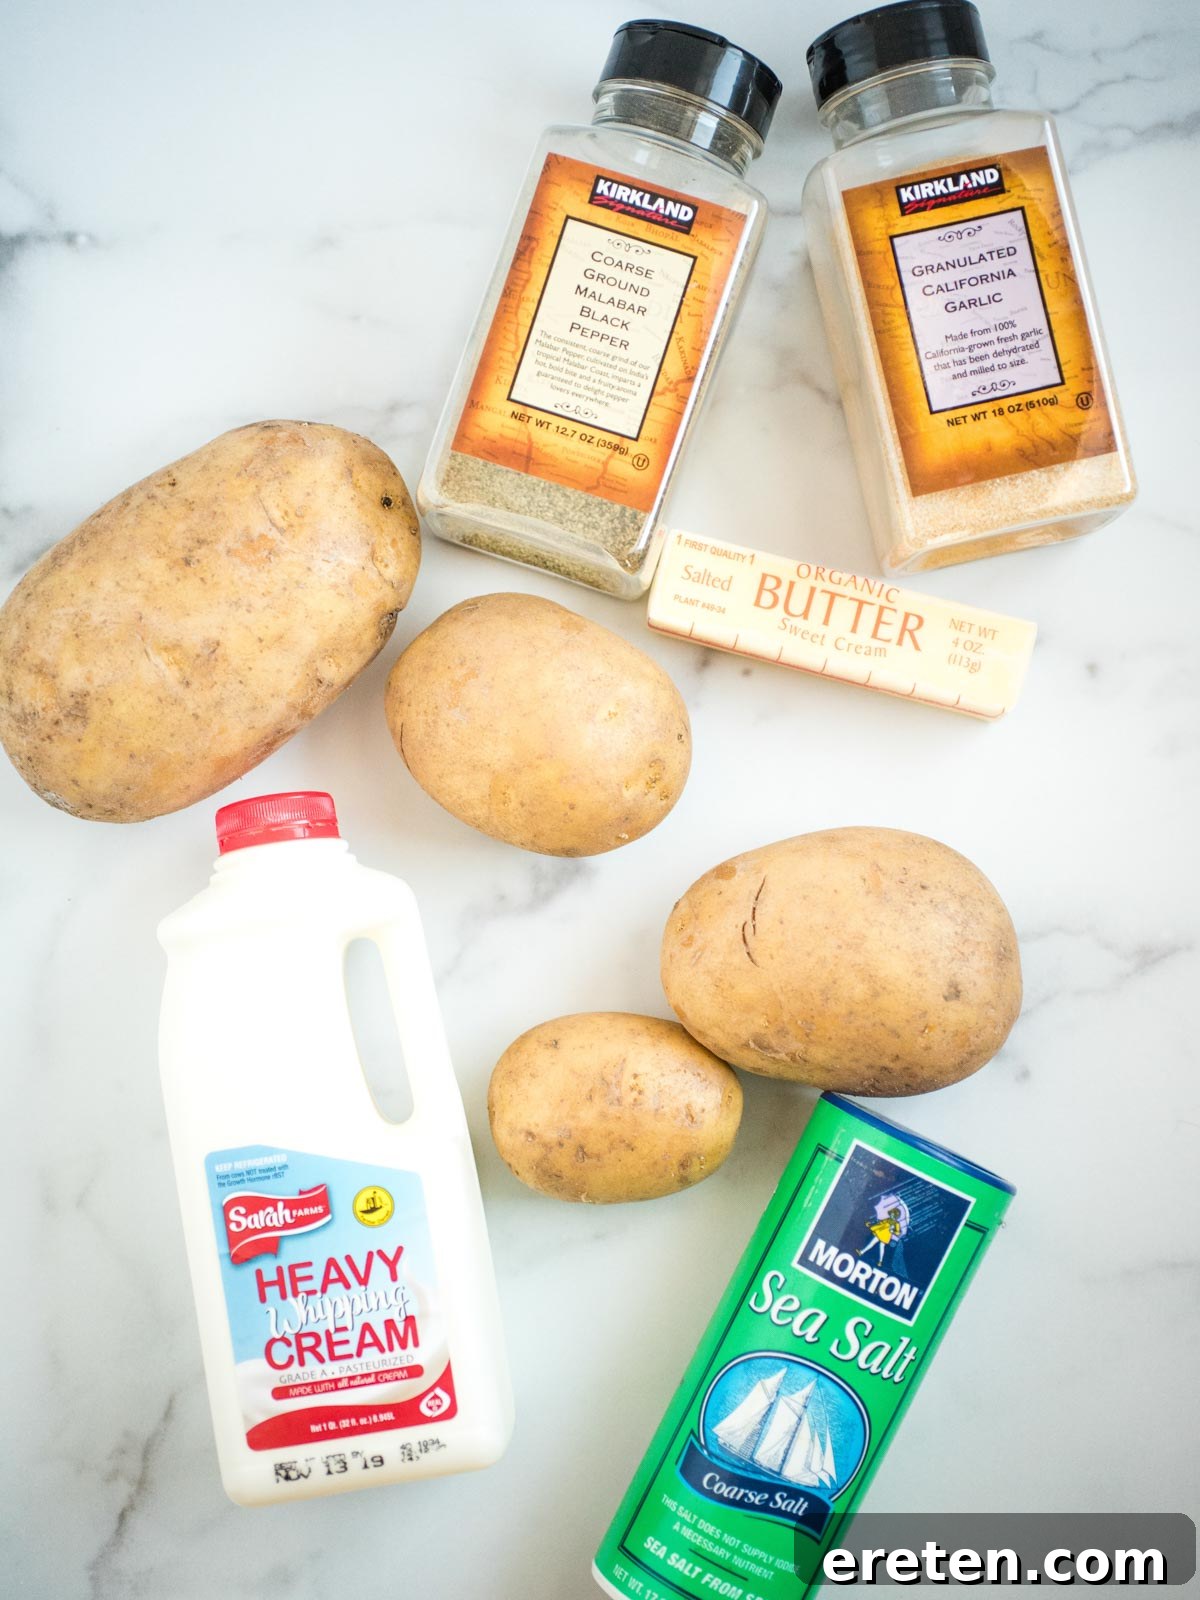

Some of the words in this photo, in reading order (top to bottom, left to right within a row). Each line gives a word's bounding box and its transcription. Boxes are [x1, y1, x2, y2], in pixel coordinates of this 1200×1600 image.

[596, 179, 693, 221] KIRKLAND
[900, 168, 999, 202] KIRKLAND
[904, 187, 999, 214] Signature
[592, 196, 689, 230] Signature
[590, 251, 655, 279] COARSE
[912, 246, 1017, 277] GRANULATED
[583, 268, 650, 297] GROUND
[922, 268, 1017, 297] CALIFORNIA
[575, 285, 647, 316] MALABAR
[944, 292, 1003, 313] GARLIC
[580, 306, 631, 331] BLACK
[945, 331, 969, 344] Made
[970, 326, 992, 338] from
[994, 320, 1017, 332] 100%
[540, 330, 552, 340] The
[553, 336, 587, 351] consistent,
[589, 346, 610, 358] coarse
[611, 353, 629, 364] grind
[630, 359, 638, 367] of
[569, 322, 630, 350] PEPPER
[925, 337, 995, 360] California-grown
[997, 333, 1018, 346] fresh
[1020, 327, 1043, 341] garlic
[535, 339, 560, 352] Malabar
[586, 355, 618, 370] cultivated
[618, 366, 628, 374] on
[536, 350, 561, 362] tropical
[563, 357, 588, 370] Malabar
[611, 374, 636, 386] imparts
[933, 361, 951, 372] that
[952, 357, 967, 368] has
[969, 352, 990, 364] been
[992, 341, 1040, 360] dehydrated
[952, 369, 968, 380] and
[969, 363, 996, 377] milled
[997, 362, 1007, 370] to
[1009, 358, 1029, 369] size.
[536, 370, 573, 386] guaranteed
[583, 383, 604, 396] delight
[606, 391, 630, 404] pepper
[548, 363, 563, 373] bold
[565, 368, 577, 377] bite
[579, 372, 591, 381] and
[616, 385, 637, 396] aroma
[550, 384, 569, 395] lovers
[946, 415, 968, 428] NET
[971, 411, 988, 422] WT
[991, 407, 1005, 418] 18
[1007, 403, 1024, 414] OZ
[1026, 395, 1059, 412] (510g)
[510, 410, 532, 424] NET
[535, 418, 553, 430] WT
[555, 425, 577, 438] 12.7
[579, 433, 595, 445] OZ
[596, 438, 630, 456] (359g)
[684, 539, 708, 553] FIRST
[709, 545, 747, 562] QUALITY
[681, 564, 733, 592] Salted
[796, 563, 900, 604] ORGANIC
[673, 594, 701, 609] PLANT
[753, 572, 925, 652] BUTTER
[777, 617, 826, 647] Sweet
[834, 636, 888, 658] Cream
[949, 618, 977, 635] NET
[977, 627, 999, 641] WT
[951, 638, 961, 649] 4
[947, 653, 982, 674] (113g)
[216, 1173, 231, 1181] From
[258, 1166, 276, 1175] treated
[277, 1164, 289, 1172] with
[217, 1180, 226, 1188] the
[226, 1178, 246, 1187] Growth
[247, 1175, 271, 1184] Hormone
[228, 1201, 295, 1232] Sarah
[292, 1205, 325, 1218] FARMS
[255, 1245, 404, 1304] HEAVY
[808, 1239, 918, 1310] MORTON
[266, 1284, 411, 1339] Whipping
[749, 1270, 828, 1343] Sea
[829, 1317, 918, 1384] Salt
[264, 1315, 420, 1371] CREAM
[279, 1371, 319, 1385] GRADE
[320, 1369, 328, 1377] A
[339, 1354, 415, 1375] PASTEURIZED
[289, 1385, 313, 1397] MADE
[313, 1381, 335, 1394] WITH
[337, 1378, 350, 1389] all
[350, 1374, 376, 1387] natural
[377, 1370, 409, 1383] CREAM
[310, 1423, 322, 1433] Net
[322, 1422, 327, 1431] 1
[325, 1460, 348, 1476] 13
[362, 1455, 385, 1470] 19
[702, 1472, 769, 1506] Coarse
[769, 1491, 809, 1517] Salt
[662, 1494, 678, 1512] THIS
[677, 1506, 698, 1524] SALT
[697, 1518, 721, 1539] DOES
[722, 1533, 741, 1549] NOT
[741, 1543, 774, 1564] SUPPLY
[672, 1521, 680, 1532] A
[680, 1525, 732, 1562] NECESSARY
[612, 1564, 629, 1583] NET
[628, 1576, 643, 1596] WT.
[643, 1536, 667, 1561] SEA
[667, 1550, 702, 1579] SALT
[701, 1573, 743, 1600] FROM
